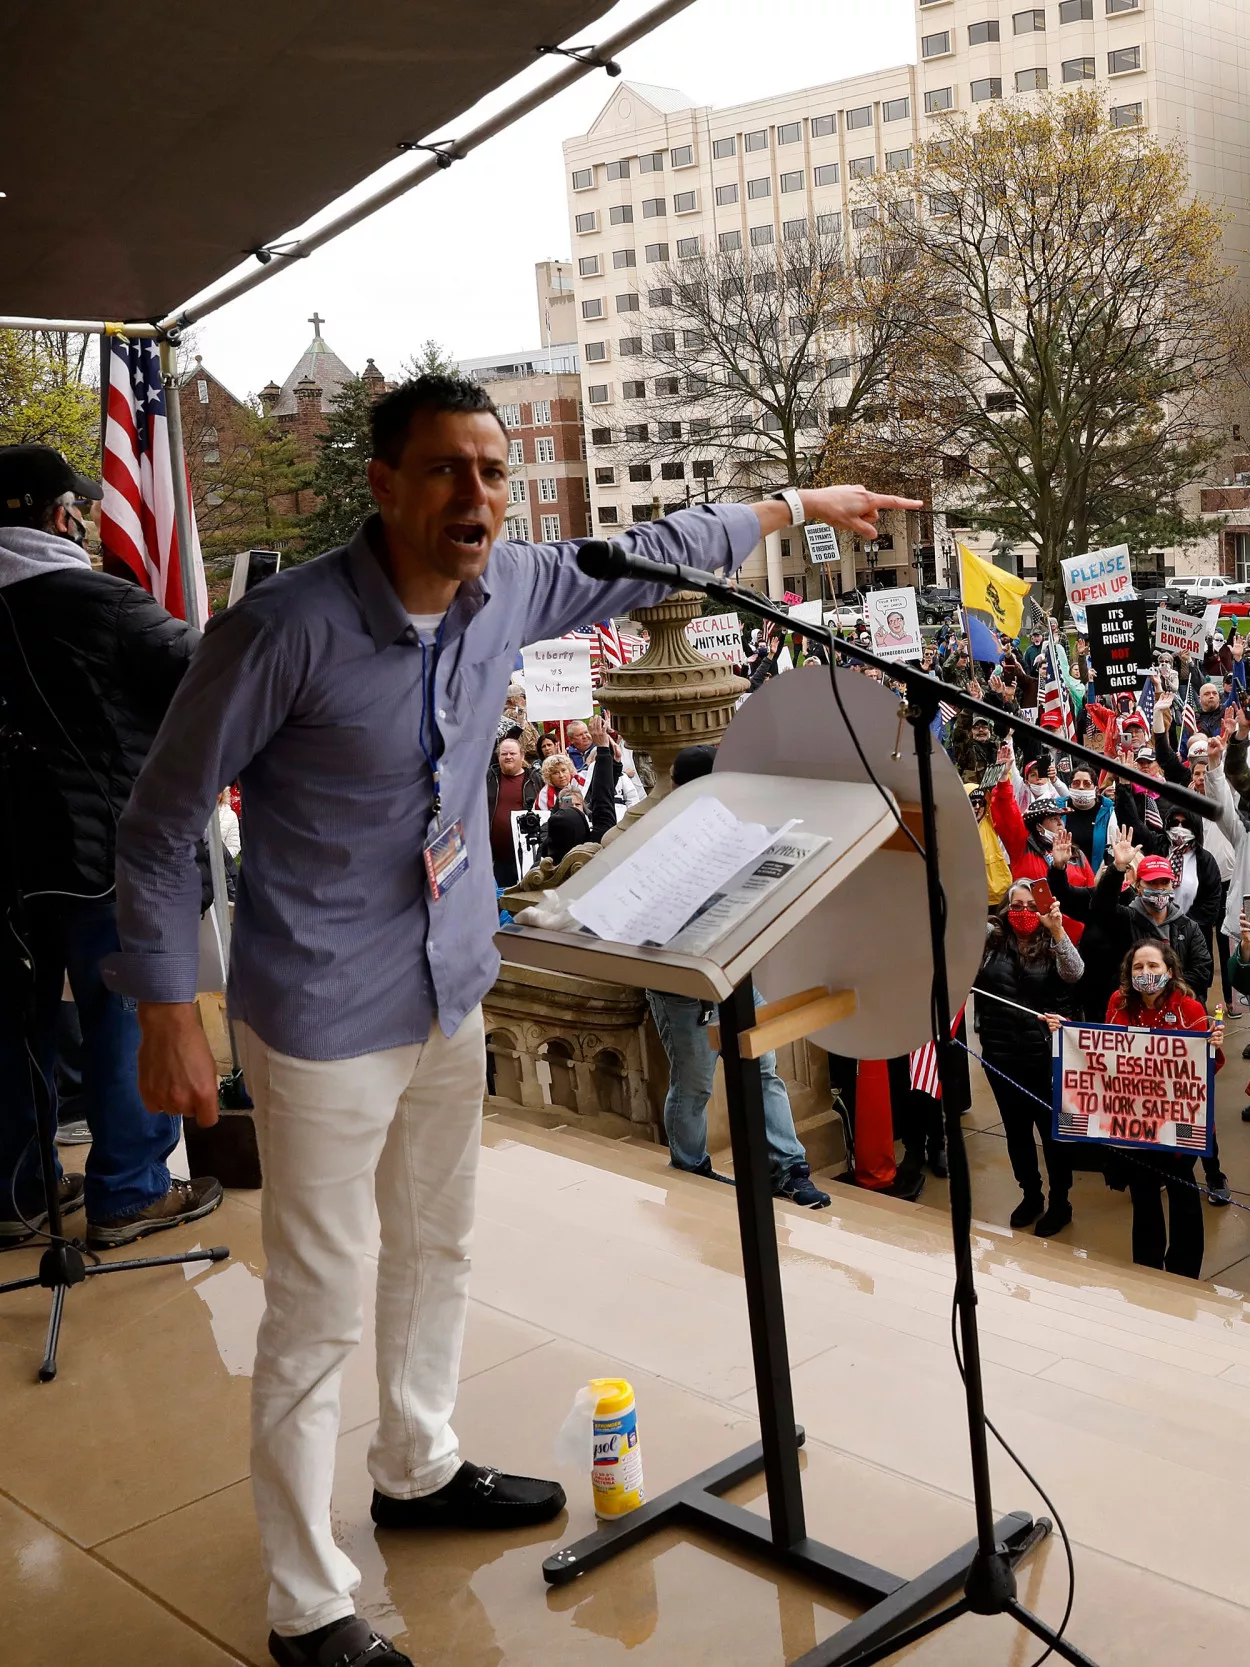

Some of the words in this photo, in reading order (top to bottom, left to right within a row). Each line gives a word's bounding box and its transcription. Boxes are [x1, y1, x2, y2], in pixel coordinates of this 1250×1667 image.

[816, 544, 835, 552] OBEDIENCE
[1070, 556, 1126, 584] PLEASE
[1071, 581, 1107, 605] OPEN
[1110, 576, 1128, 592] UP
[1108, 609, 1124, 620] IT'S
[1162, 614, 1171, 622] The
[1172, 616, 1193, 628] VACCINE
[686, 618, 734, 634] RECALL
[1101, 622, 1120, 632] BILL
[1122, 620, 1134, 630] OF
[1176, 626, 1186, 636] the
[686, 633, 740, 650] WHITMER
[1102, 632, 1135, 645] RIGHTS
[1160, 632, 1200, 653] BOXCAR
[536, 650, 574, 662] Liberty
[1111, 648, 1130, 660] NOT
[1106, 664, 1126, 676] BILL
[1127, 662, 1138, 672] OF
[534, 682, 580, 692] Whitmer
[1110, 676, 1137, 687] GATES
[779, 845, 810, 858] PRESS
[1078, 1030, 1136, 1053] EVERY
[1145, 1036, 1188, 1058] JOB
[1086, 1052, 1108, 1072] IS
[1116, 1055, 1202, 1082] ESSENTIAL
[1064, 1070, 1096, 1090] GET
[1101, 1075, 1168, 1098] WORKERS
[1172, 1080, 1206, 1102] BACK
[1077, 1092, 1098, 1114] TO
[1102, 1094, 1136, 1116] WORK
[1142, 1100, 1200, 1124] SAFELY
[1111, 1117, 1158, 1140] NOW
[594, 1435, 618, 1460] ysol
